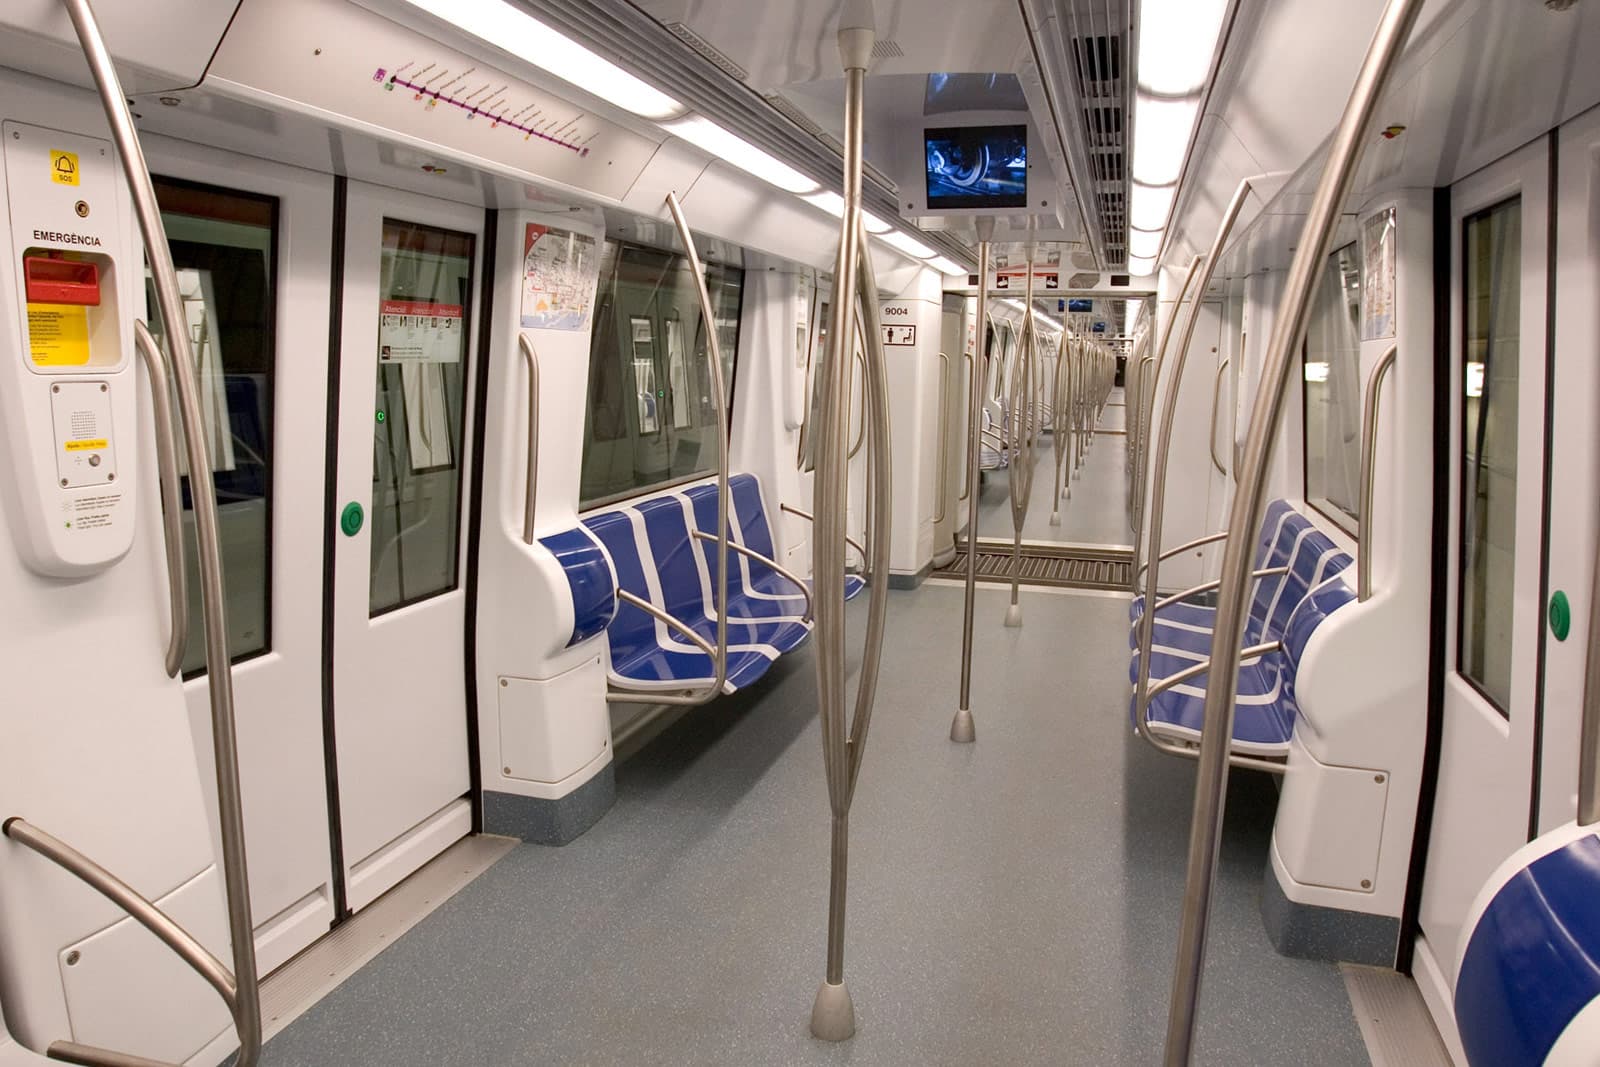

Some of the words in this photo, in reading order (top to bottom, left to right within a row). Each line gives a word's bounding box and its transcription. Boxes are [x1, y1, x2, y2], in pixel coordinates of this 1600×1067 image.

[58, 174, 73, 183] SOS
[33, 230, 101, 247] EMERGÈNCIA
[885, 307, 908, 316] 9004
